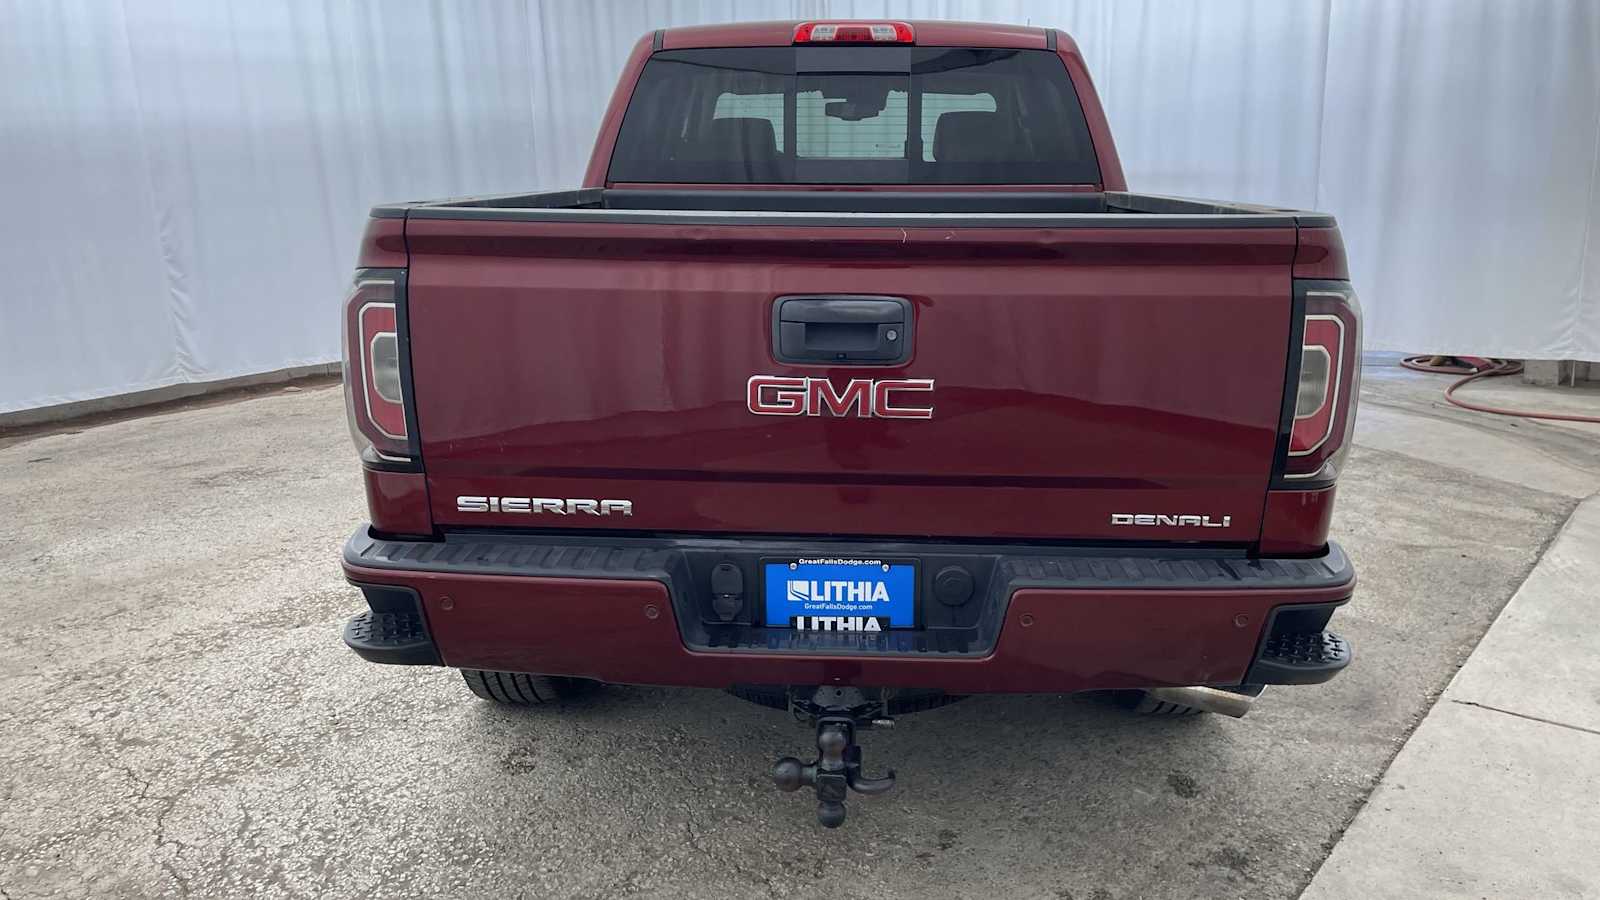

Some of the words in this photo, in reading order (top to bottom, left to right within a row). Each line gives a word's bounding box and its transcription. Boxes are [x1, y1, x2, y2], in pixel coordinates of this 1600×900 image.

[747, 375, 935, 419] GMC
[456, 495, 633, 517] SIERRA
[1111, 513, 1231, 528] DENALI
[799, 558, 881, 566] GreatFallsDodge.com
[811, 580, 890, 602] LITHIA
[804, 603, 873, 611] GreatFallsDodge.com
